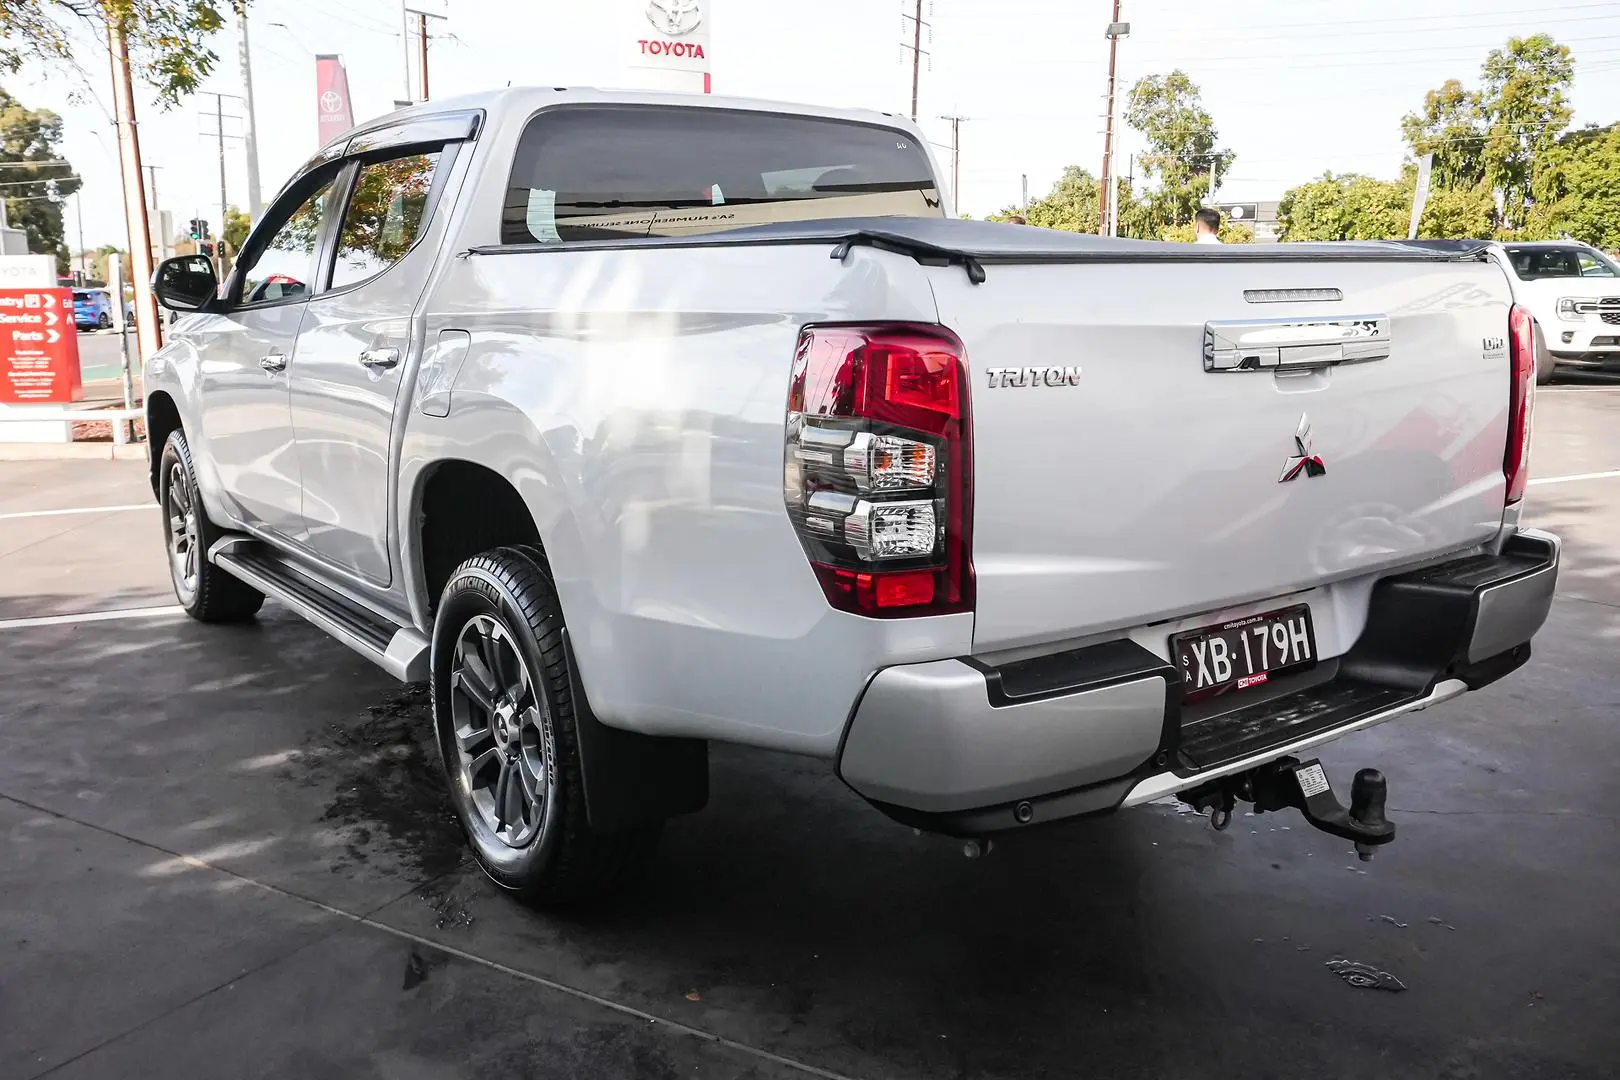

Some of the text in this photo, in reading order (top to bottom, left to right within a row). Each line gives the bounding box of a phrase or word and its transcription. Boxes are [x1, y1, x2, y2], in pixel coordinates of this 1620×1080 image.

[638, 40, 705, 59] TOYOTA
[12, 330, 44, 341] Parts
[986, 366, 1082, 389] TRITON
[457, 576, 500, 602] MICHELIN
[1223, 616, 1264, 630] cmitoyota.com.au
